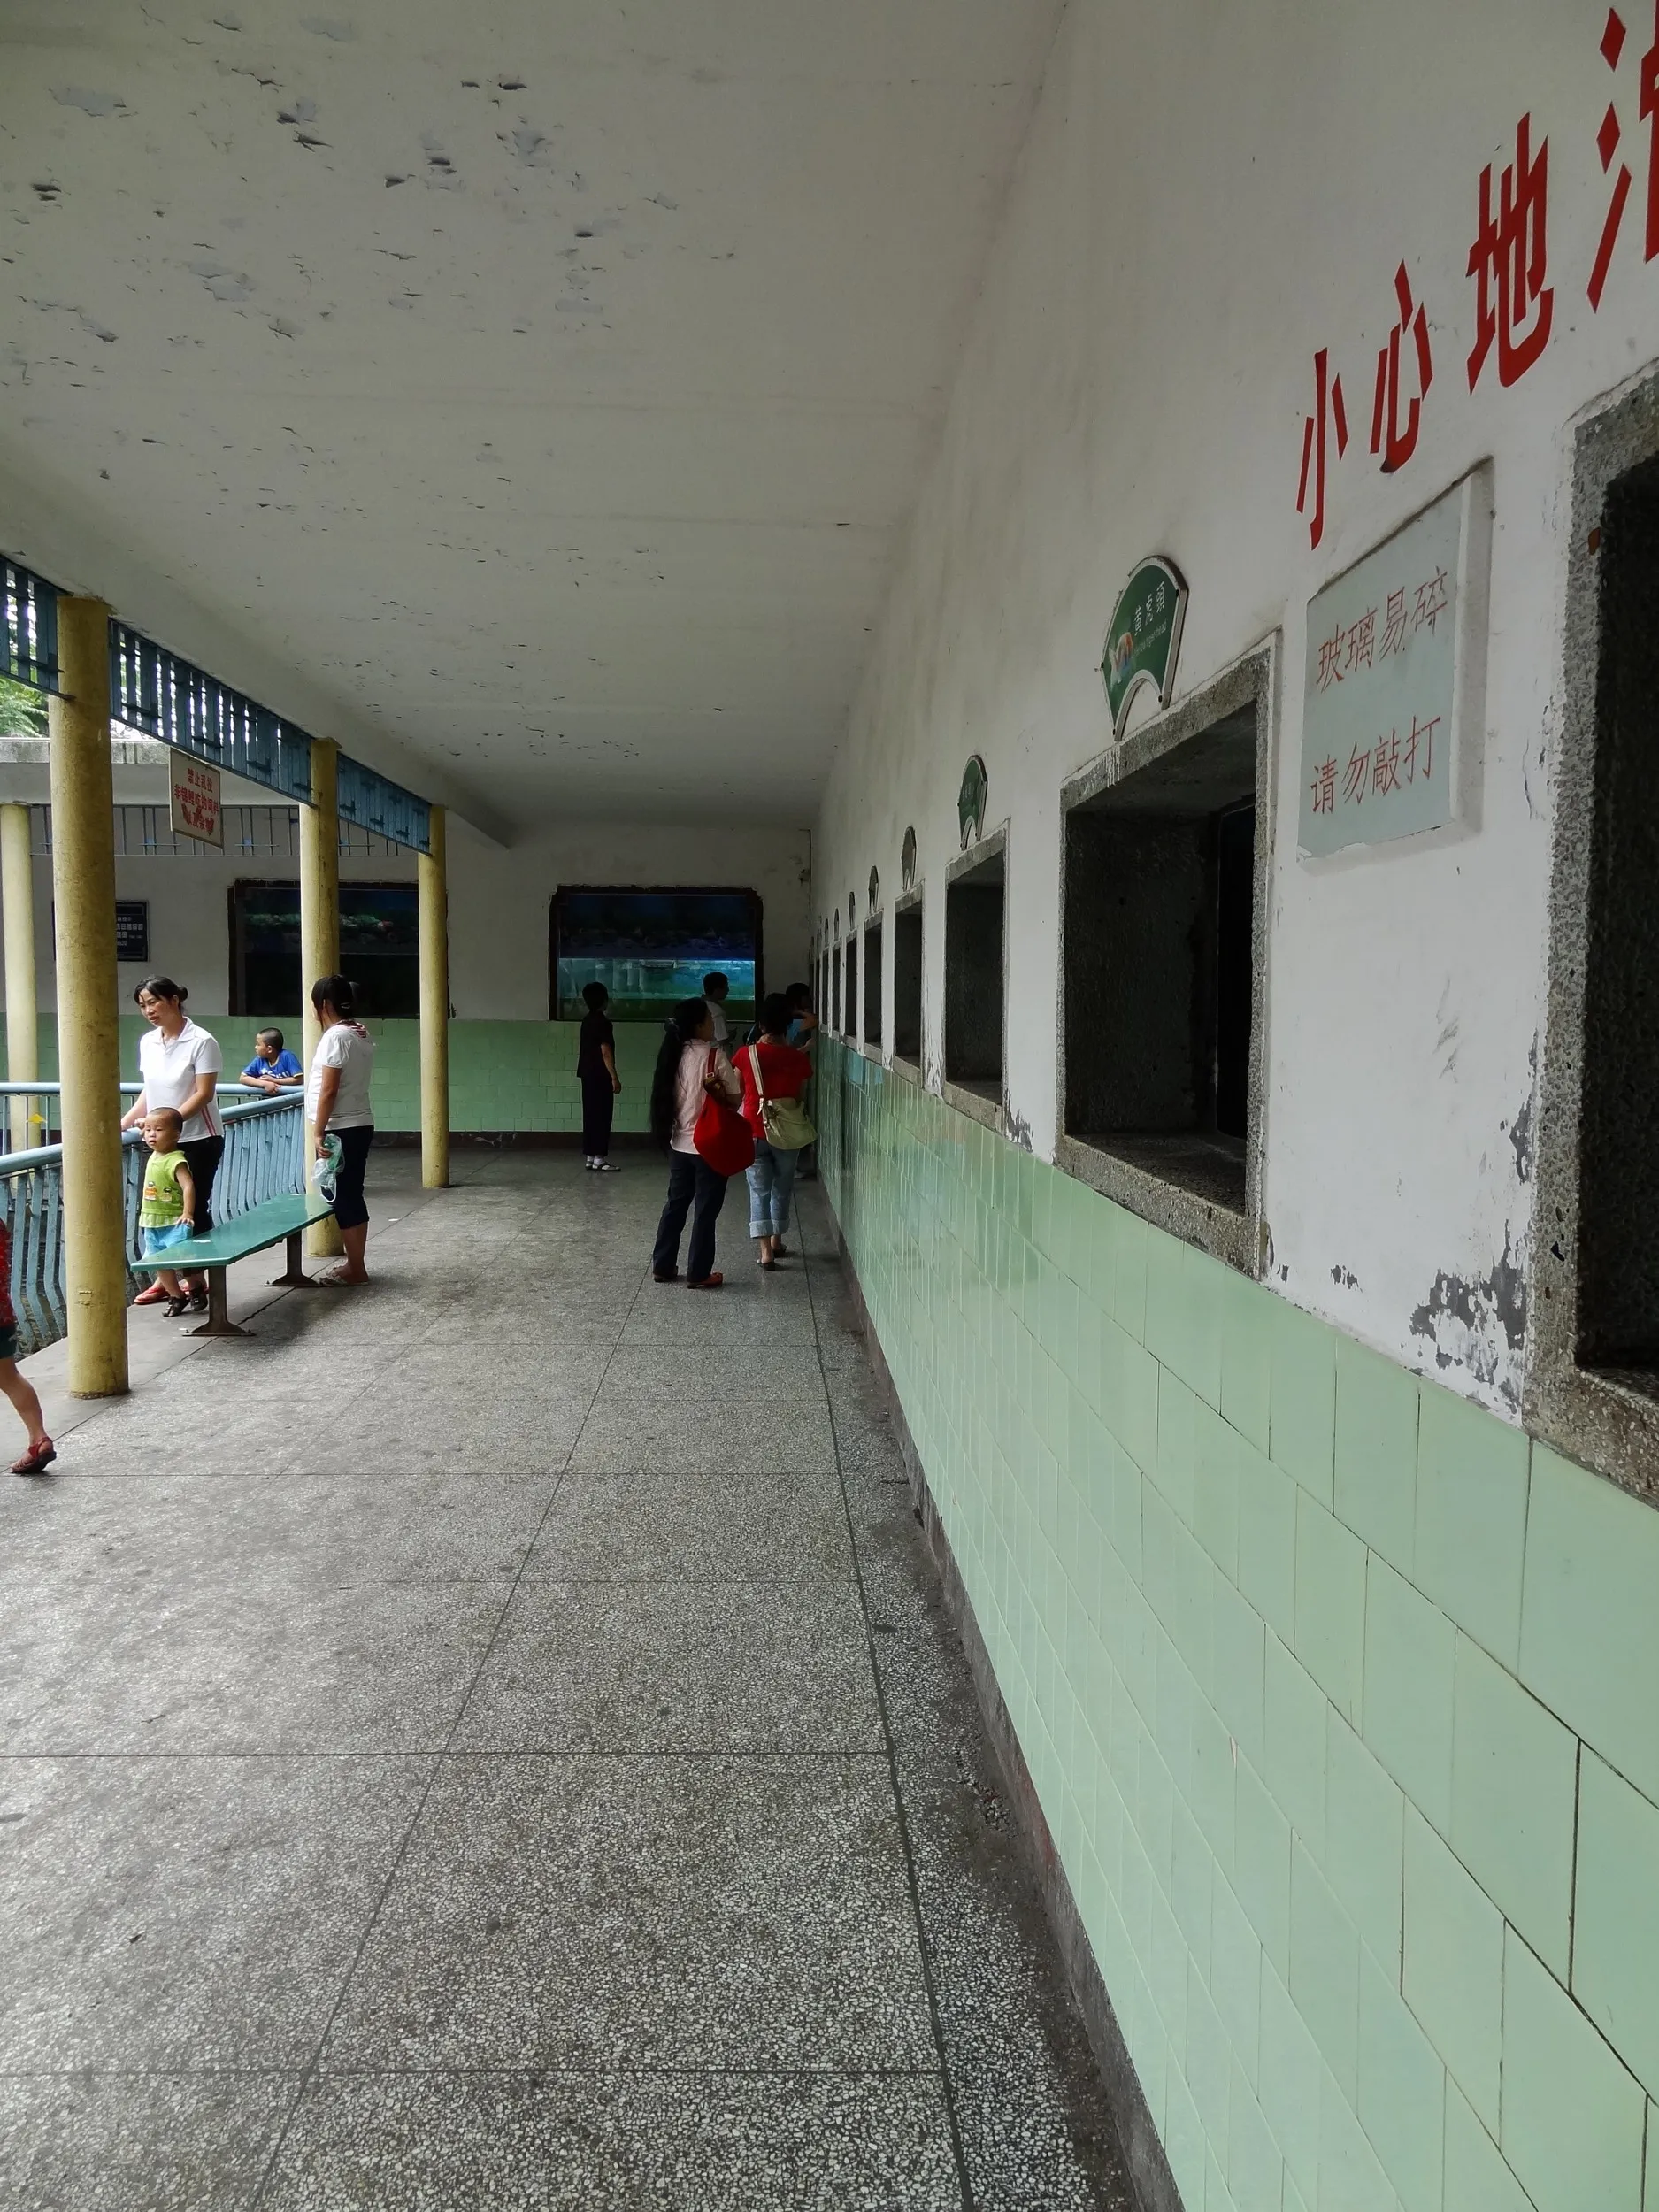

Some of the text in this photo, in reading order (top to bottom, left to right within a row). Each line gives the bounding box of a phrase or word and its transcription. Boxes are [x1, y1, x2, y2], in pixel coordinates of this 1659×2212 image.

[1316, 566, 1448, 694] 玻璃易碎
[1310, 715, 1441, 815] 请勿敲打
